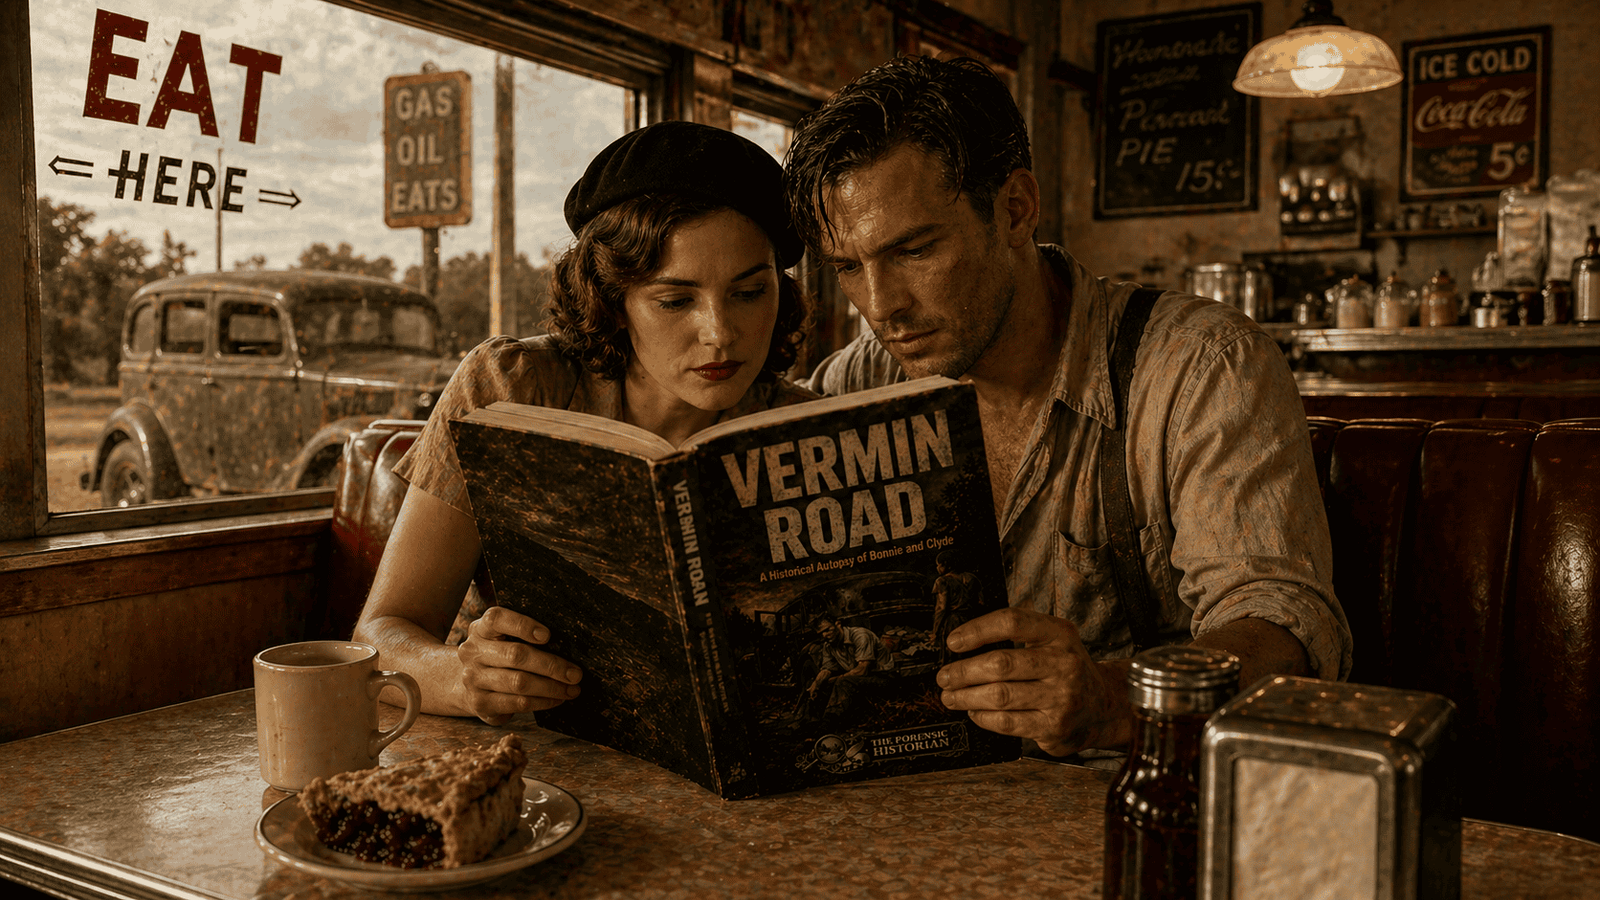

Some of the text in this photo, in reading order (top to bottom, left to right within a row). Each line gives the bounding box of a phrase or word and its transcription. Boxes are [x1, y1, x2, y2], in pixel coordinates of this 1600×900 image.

[83, 8, 283, 144] EAT
[1419, 46, 1532, 81] ICE COLD
[394, 85, 453, 119] GAS
[1414, 86, 1535, 133] Coca-Cola
[396, 135, 444, 166] OIL
[1115, 136, 1179, 167] PIE
[108, 149, 248, 213] HERE
[392, 179, 458, 213] EATS
[721, 408, 954, 508] VERMIN
[764, 480, 927, 563] ROAD
[760, 535, 954, 583] A Historical Autopsy of Bonnie and Clyde
[870, 736, 893, 747] THE
[873, 737, 950, 757] HISTORIAN
